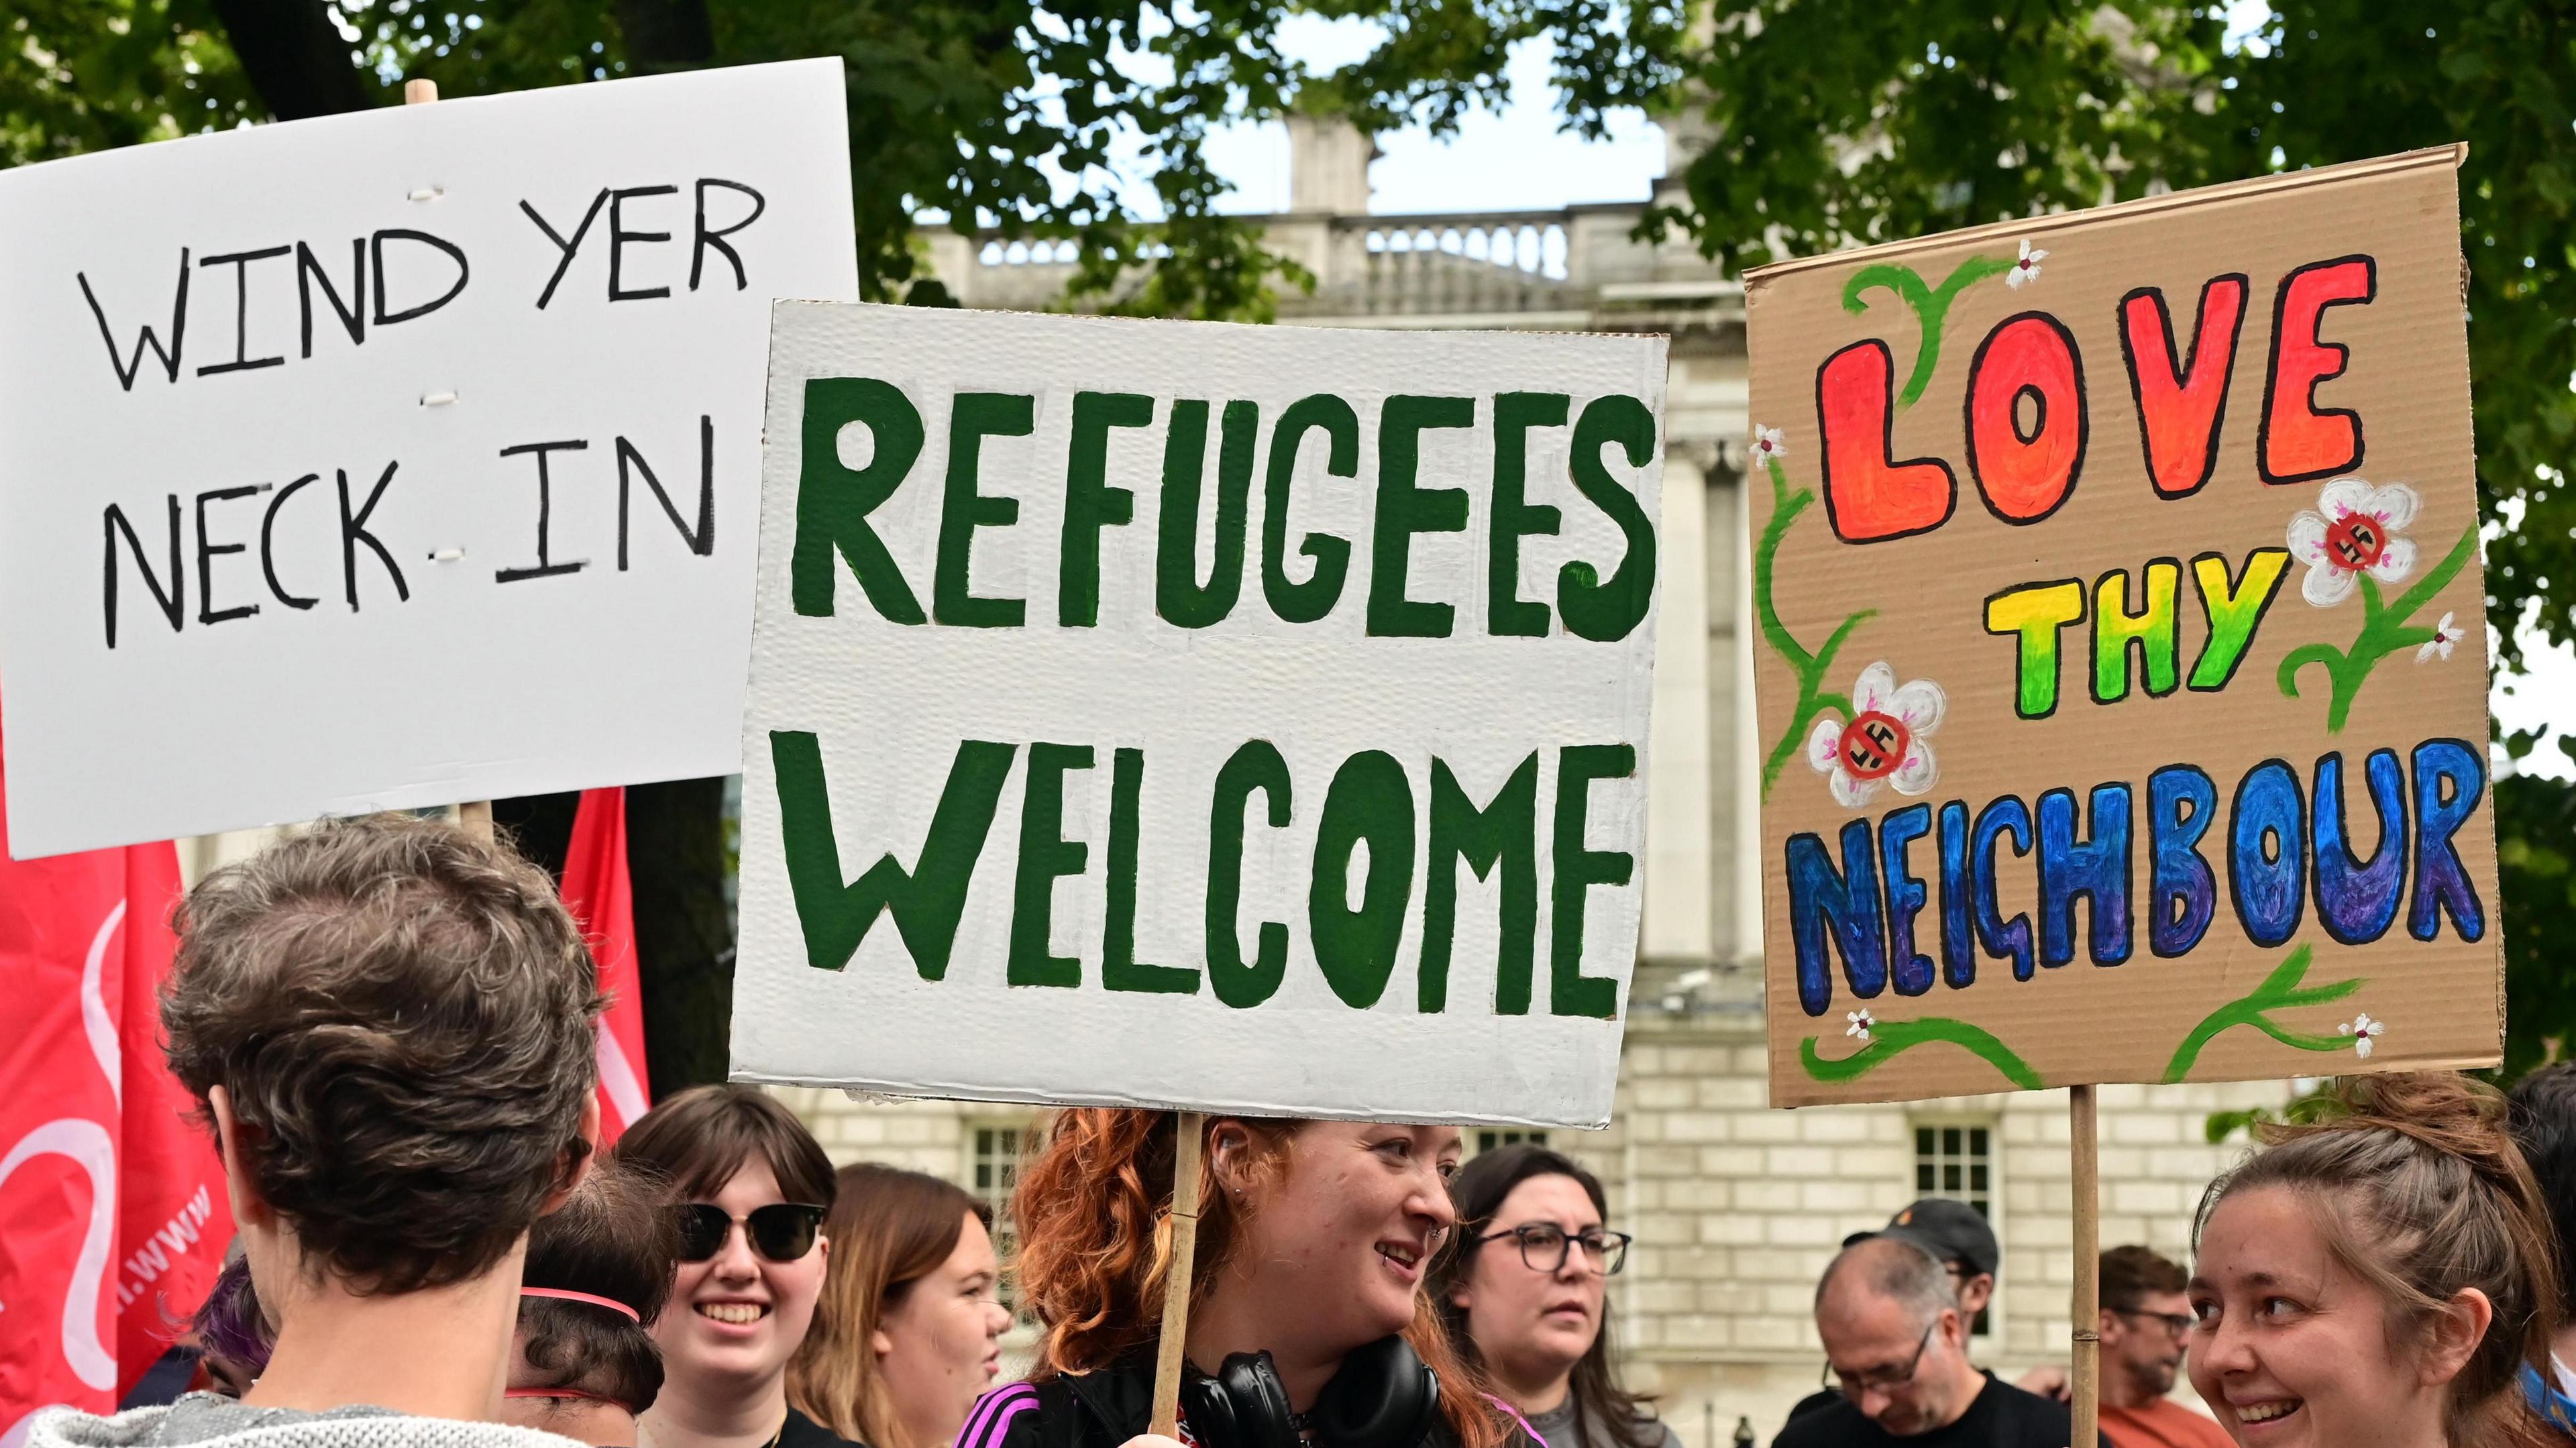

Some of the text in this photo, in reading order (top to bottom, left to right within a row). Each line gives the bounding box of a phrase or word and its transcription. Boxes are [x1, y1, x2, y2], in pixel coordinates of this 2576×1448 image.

[78, 178, 765, 391] WIND YER
[1816, 255, 2376, 543] LOVE
[104, 415, 714, 649] NECK IN
[792, 377, 1656, 643] REFUGEES
[1984, 547, 2291, 719] THY
[771, 730, 1635, 1019] WELCOME
[1785, 738, 2485, 1016] NEIGHBOUR
